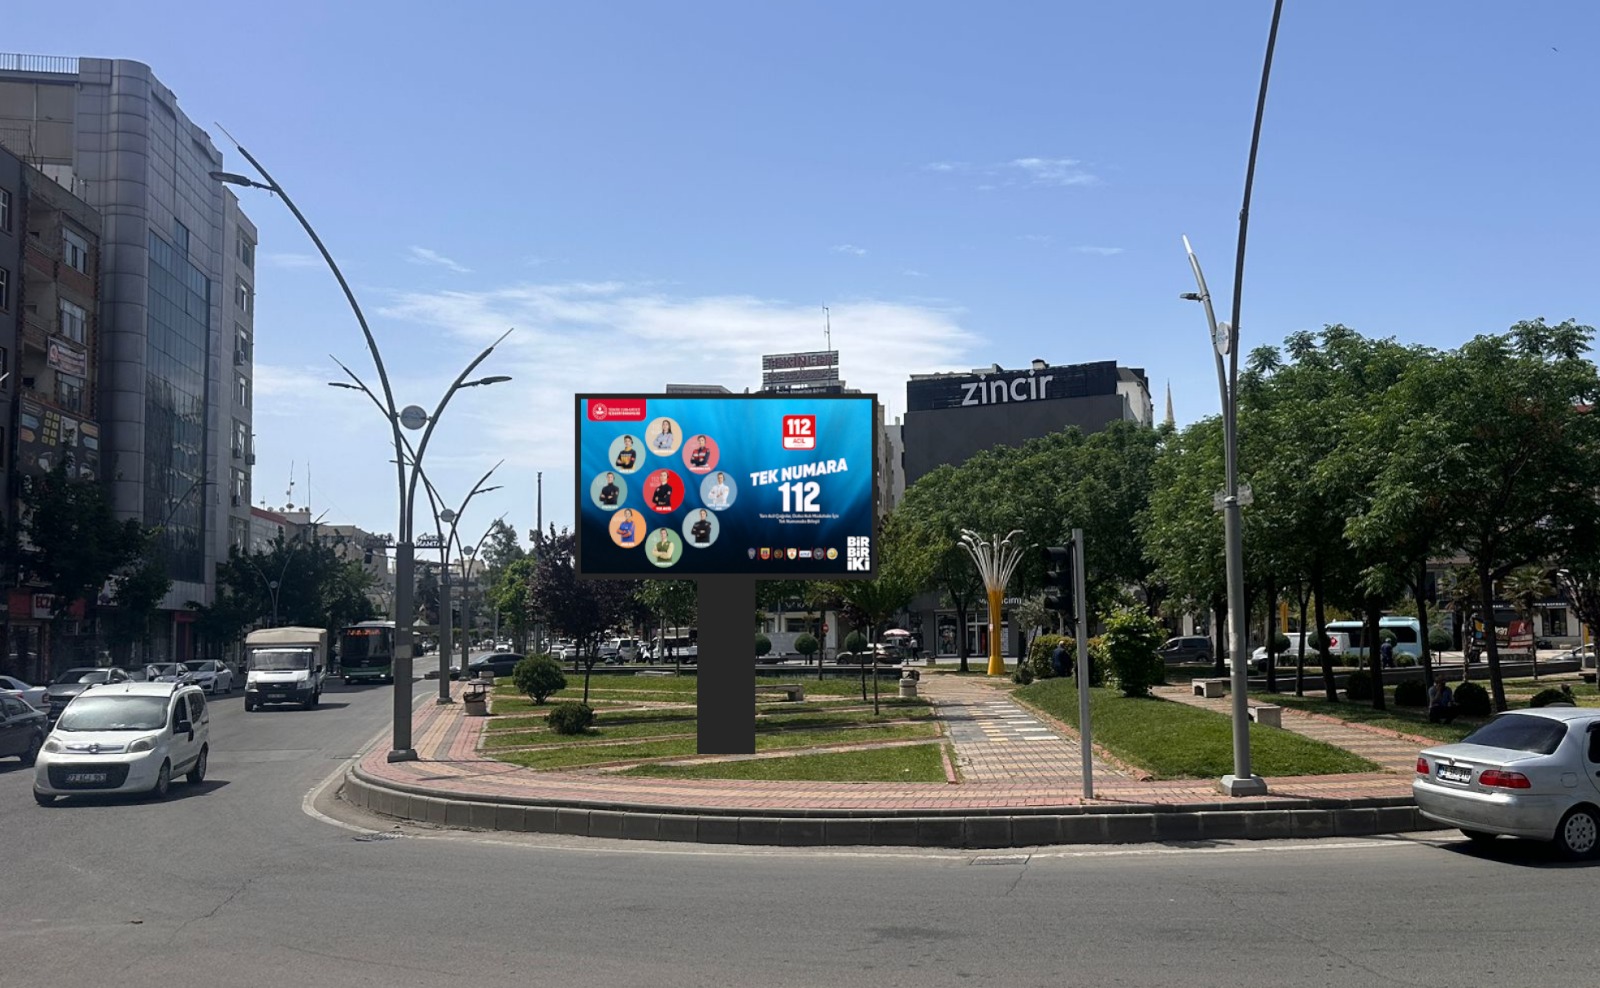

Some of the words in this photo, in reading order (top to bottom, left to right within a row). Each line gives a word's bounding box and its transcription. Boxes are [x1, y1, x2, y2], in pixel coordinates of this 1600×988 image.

[961, 368, 1054, 406] zincir
[786, 418, 812, 435] 112
[750, 468, 780, 487] TEK
[781, 457, 848, 482] NUMARA
[778, 481, 821, 512] 112
